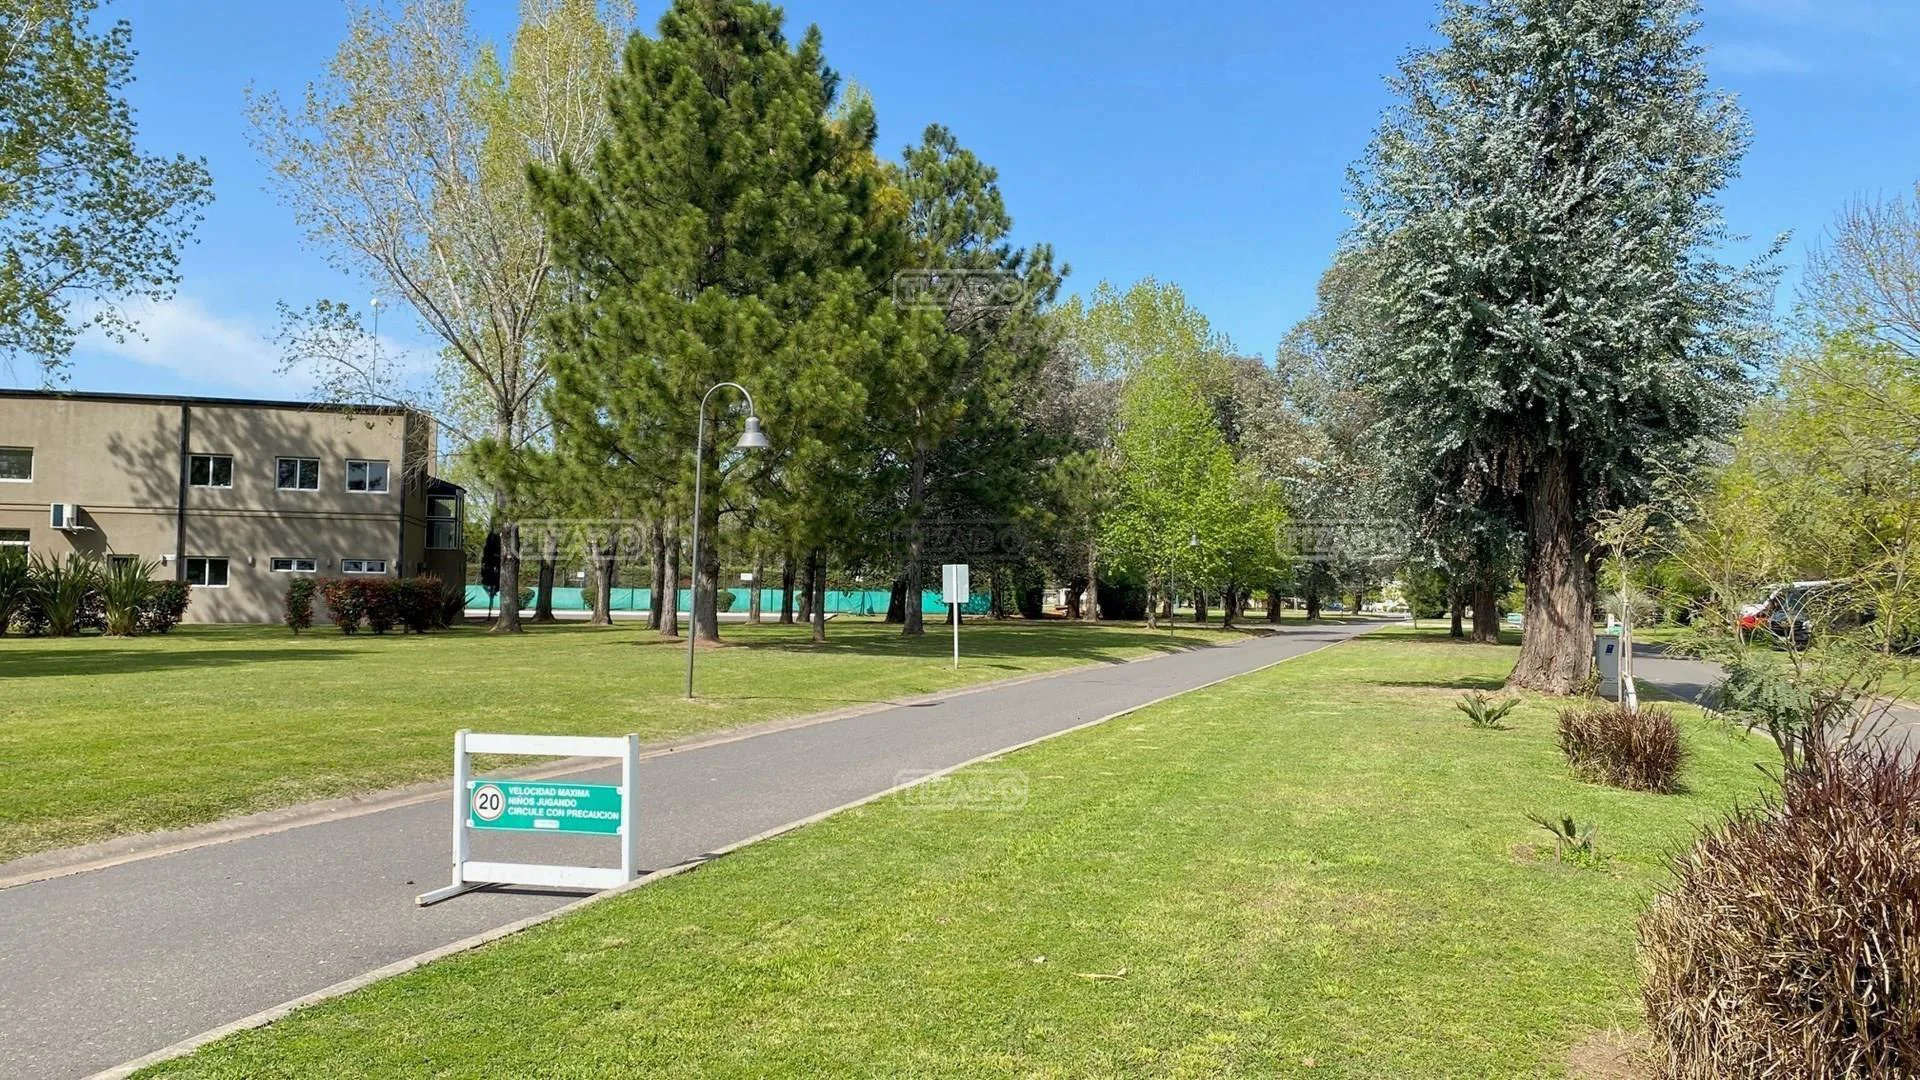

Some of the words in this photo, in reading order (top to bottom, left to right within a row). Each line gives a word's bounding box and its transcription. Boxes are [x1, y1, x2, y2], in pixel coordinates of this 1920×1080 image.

[508, 786, 556, 796] VELOCIDAD
[557, 788, 590, 798] MAXIMA
[478, 793, 500, 811] 20
[508, 795, 535, 806] NIÑOS
[536, 797, 577, 808] JUGANDO
[508, 806, 544, 816] CIRCULE
[546, 808, 565, 817] CON
[566, 809, 619, 820] PRECAUCION
